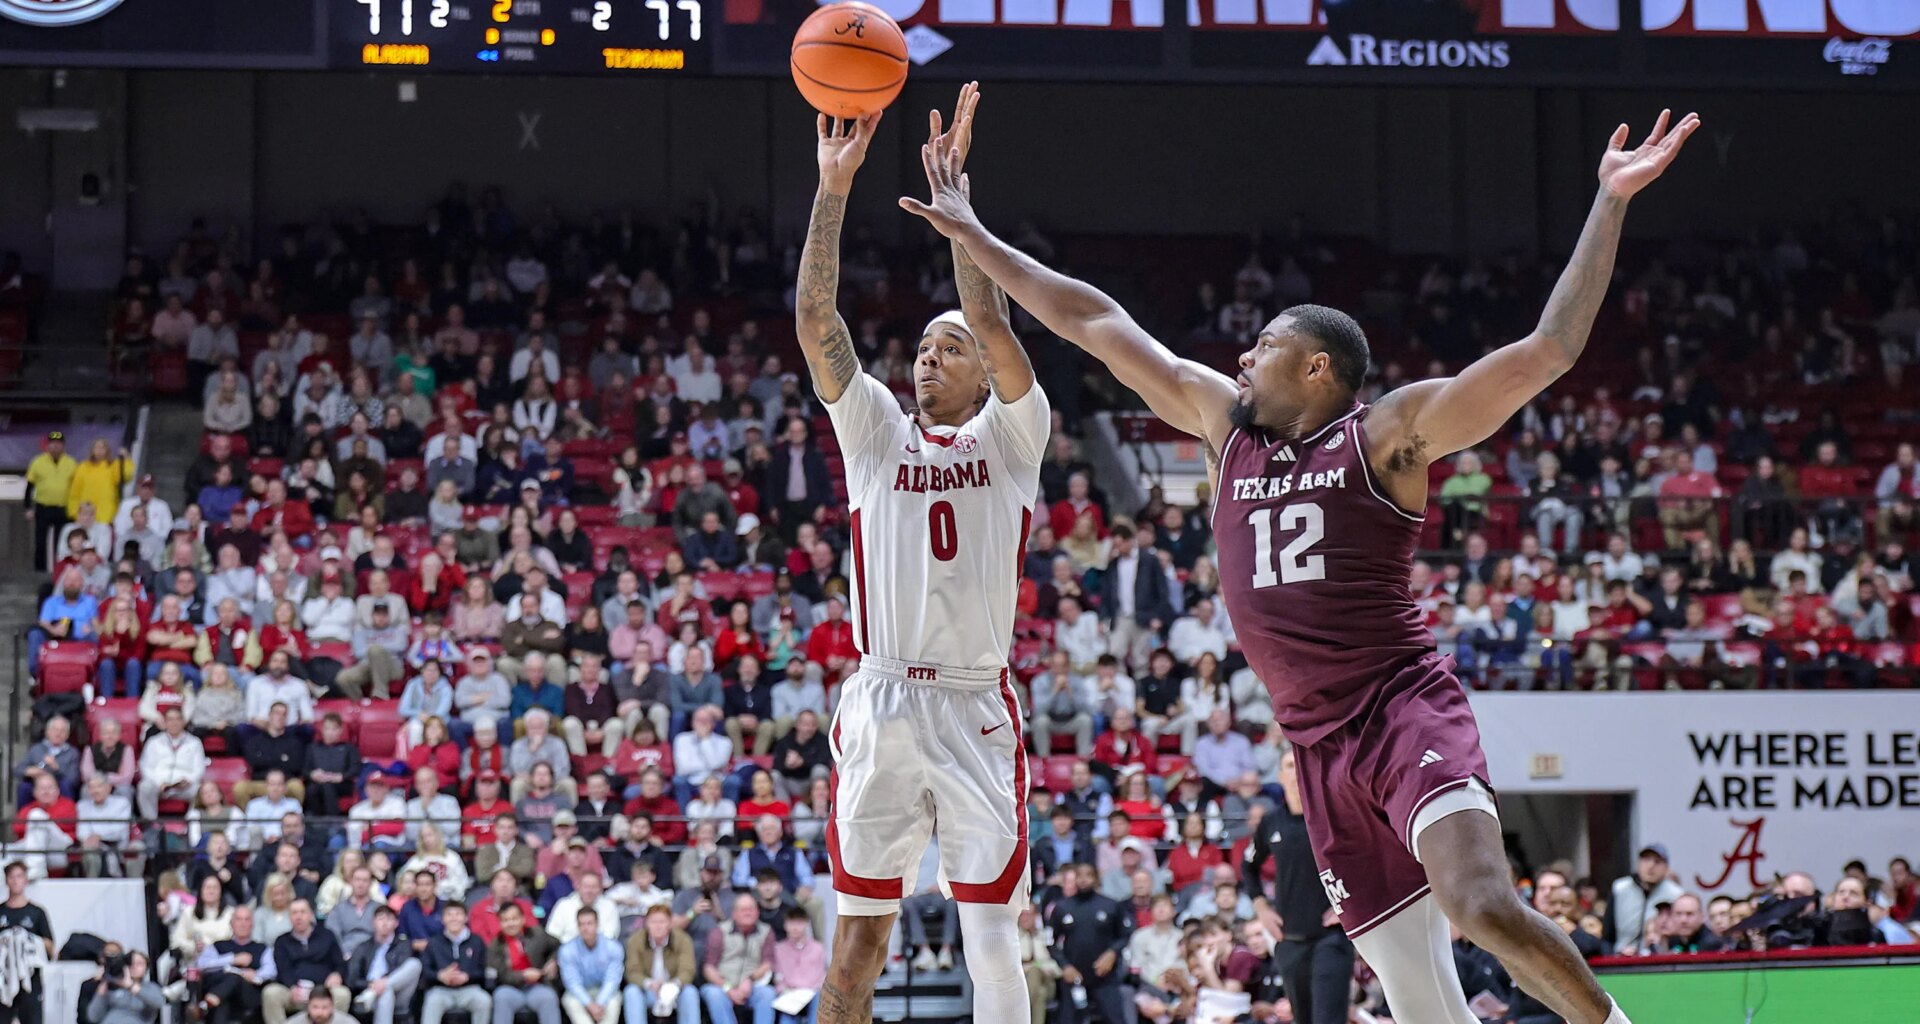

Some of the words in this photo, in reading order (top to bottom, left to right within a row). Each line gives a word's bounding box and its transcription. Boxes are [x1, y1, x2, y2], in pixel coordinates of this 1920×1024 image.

[592, 1, 612, 31] 2
[645, 0, 701, 41] 77
[893, 459, 991, 494] ALABAMA
[1232, 473, 1293, 501] TEXAS
[1298, 467, 1346, 491] A&M
[928, 500, 958, 562] 0
[1248, 502, 1326, 589] 12
[907, 666, 937, 681] RTR
[1688, 733, 1848, 766] WHERE
[1866, 733, 1920, 766] LE
[1689, 774, 1777, 809] ARE
[1793, 774, 1920, 809] MADE
